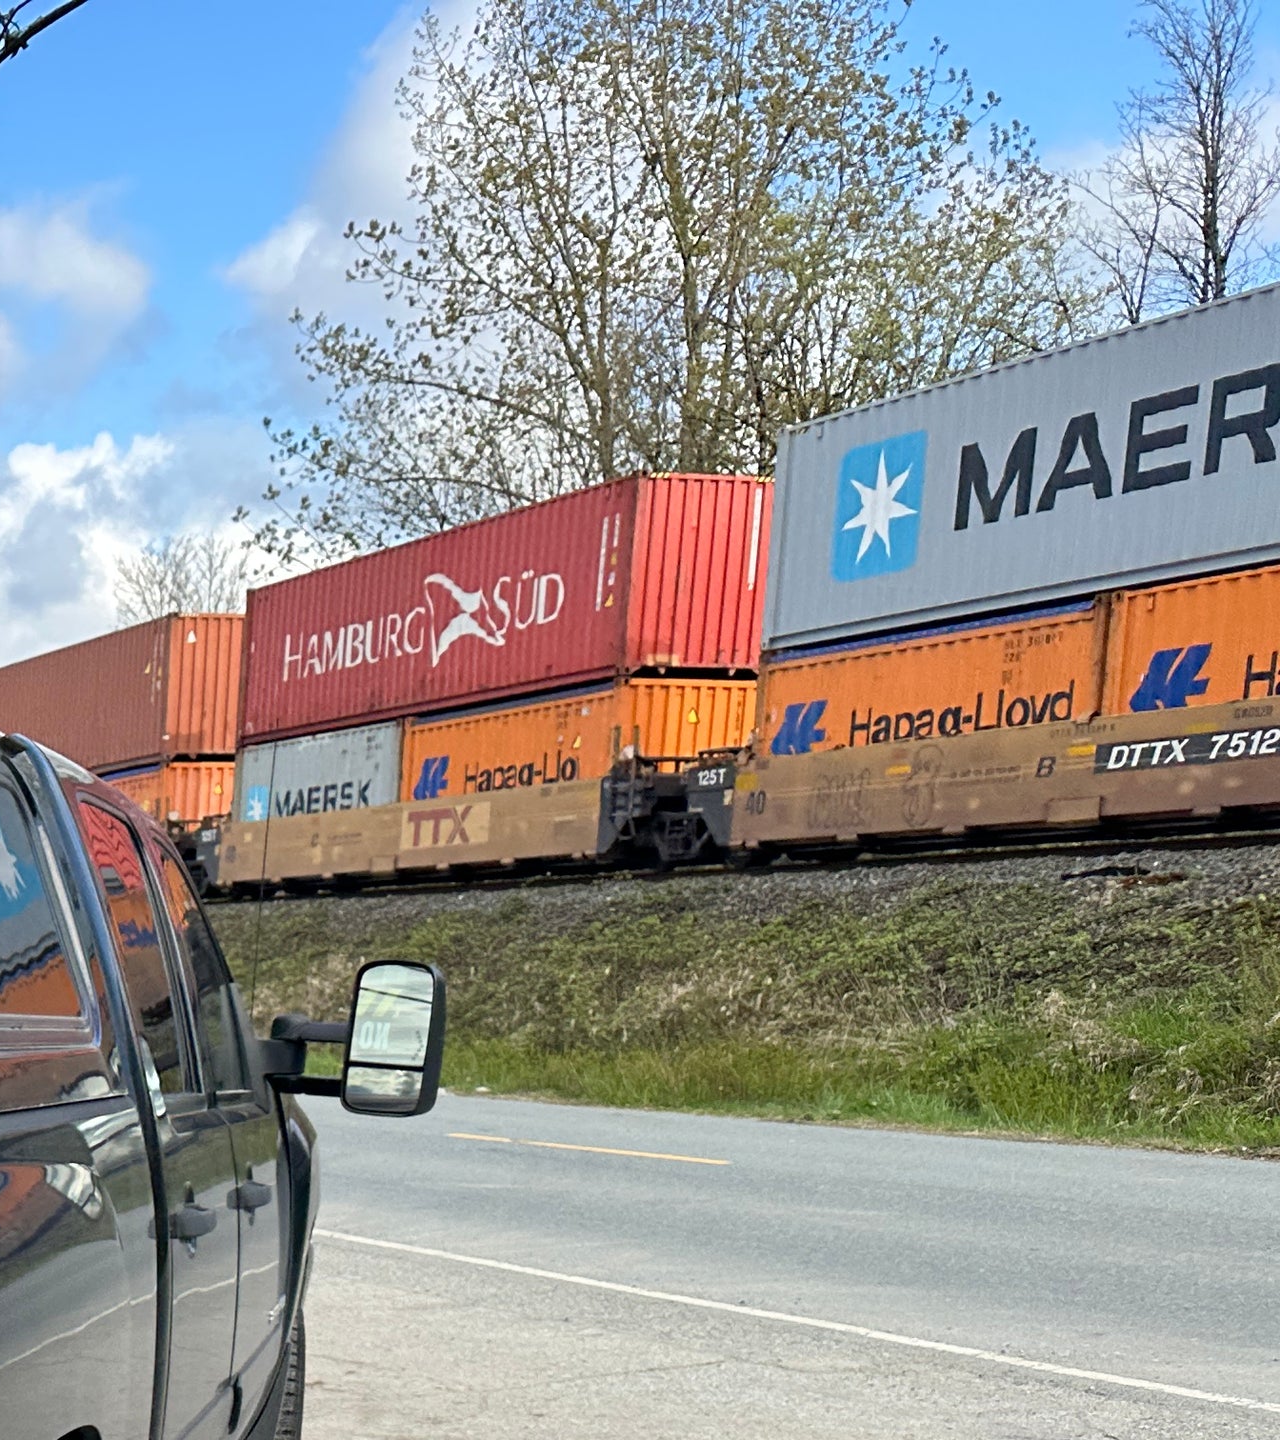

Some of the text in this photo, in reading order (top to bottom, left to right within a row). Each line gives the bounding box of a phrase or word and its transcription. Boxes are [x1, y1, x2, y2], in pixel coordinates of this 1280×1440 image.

[954, 362, 1280, 531] MAER
[283, 569, 566, 682] HAMBURG SÜD
[1106, 738, 1190, 770] DTTX
[697, 768, 726, 786] 125T
[274, 778, 371, 818] MAERSK
[408, 805, 473, 847] TTX
